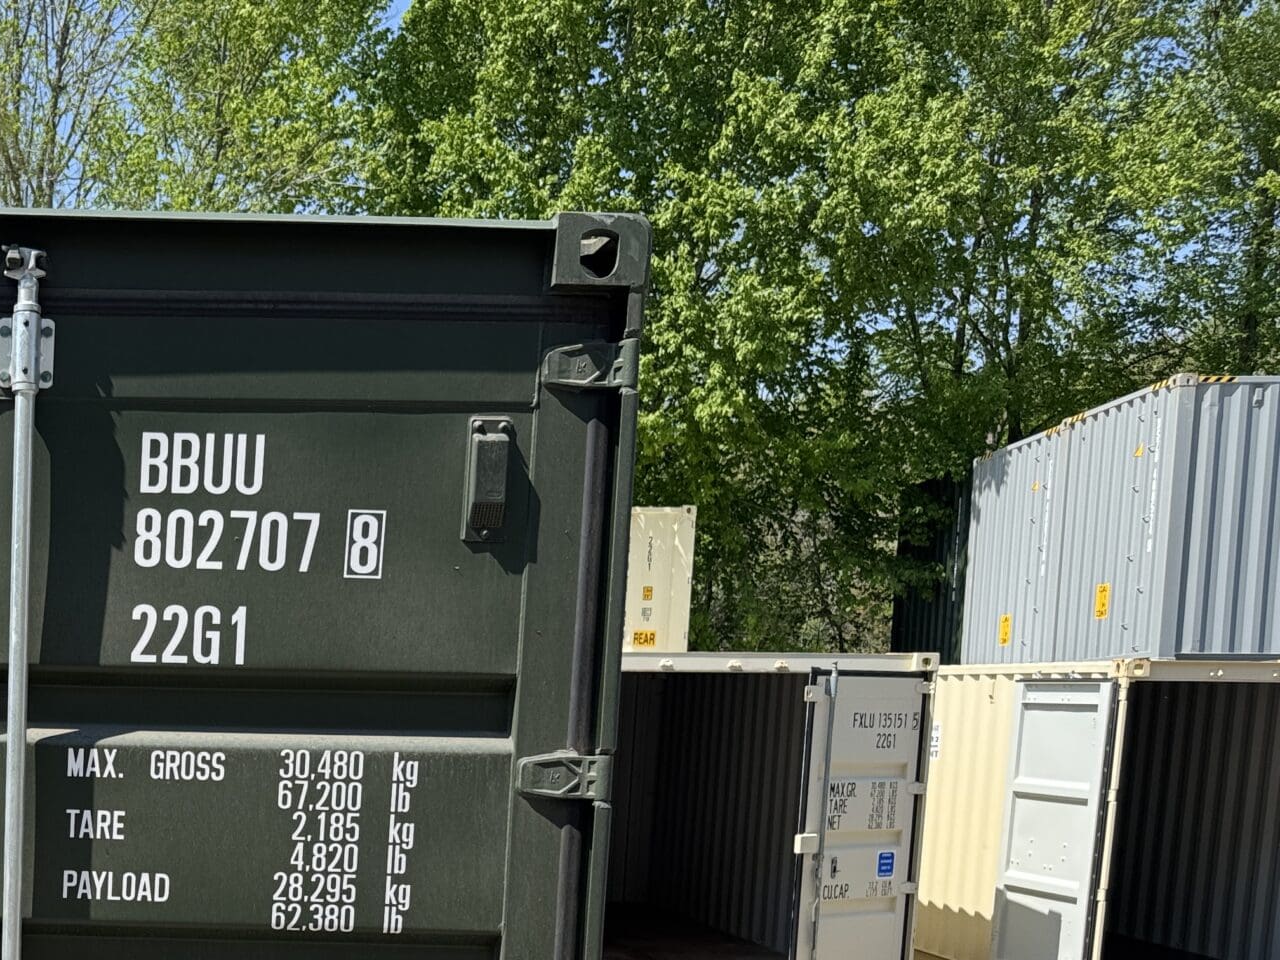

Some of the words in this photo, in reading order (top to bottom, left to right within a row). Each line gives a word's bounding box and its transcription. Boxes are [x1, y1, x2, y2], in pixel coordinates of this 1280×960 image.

[140, 431, 266, 495] BBUU
[134, 507, 320, 572] 802707
[347, 512, 381, 576] 8
[130, 604, 247, 665] 22G1
[633, 632, 655, 646] REAR
[853, 712, 875, 728] FXLU
[878, 712, 908, 729] 135151
[876, 733, 896, 749] 22G1
[66, 748, 124, 779] MAX.
[150, 750, 226, 781] GROSS
[279, 749, 364, 780] 30,480
[392, 752, 419, 788] kg
[277, 780, 362, 811] 67,200
[390, 783, 411, 812] lb
[66, 809, 126, 840] TARE
[291, 811, 360, 842] 2,185
[388, 814, 415, 849] kg
[290, 842, 359, 872] 4,820
[386, 845, 407, 874] lb
[62, 869, 170, 902] PAYLOAD
[272, 872, 356, 903] 28,295
[384, 876, 411, 911] kg
[271, 902, 355, 932] 62,380
[382, 906, 404, 934] lb
